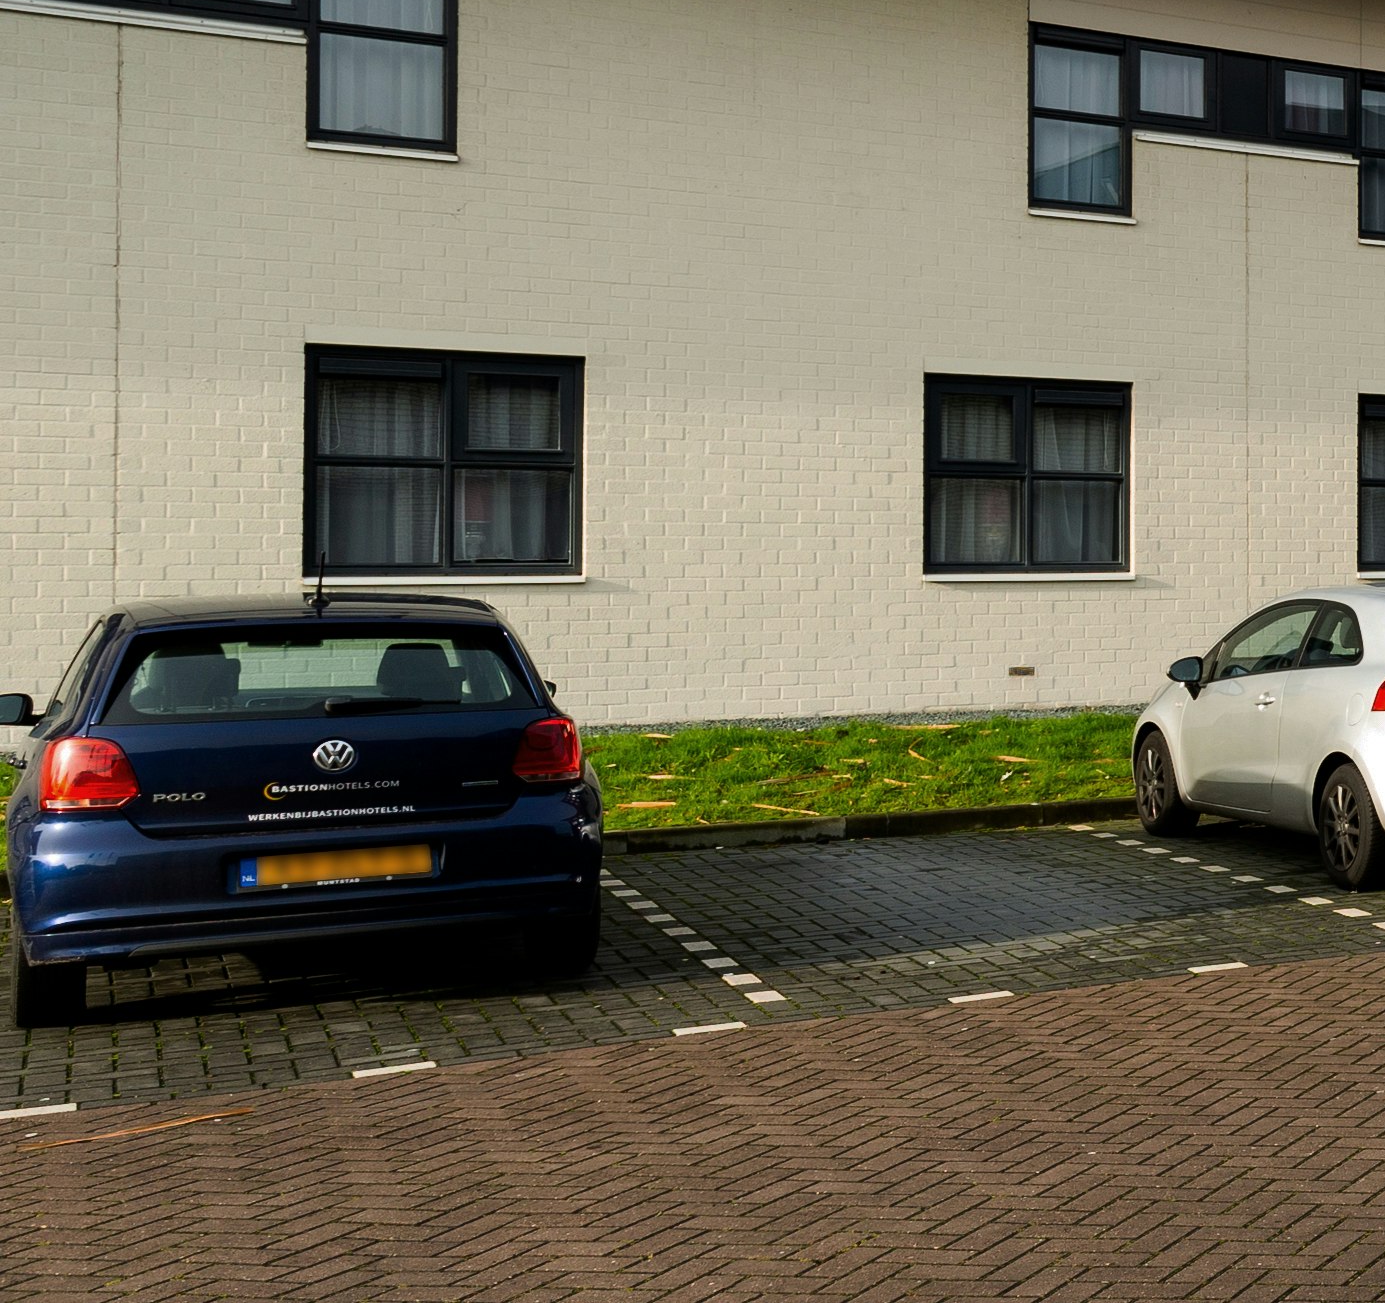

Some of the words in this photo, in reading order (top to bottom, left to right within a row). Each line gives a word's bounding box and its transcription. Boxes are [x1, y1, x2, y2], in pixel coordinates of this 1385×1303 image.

[271, 780, 400, 794] BASTIONHOTELS.COM
[152, 792, 206, 803] POLO
[248, 805, 416, 822] WERKENBIJBASTIONHOTELS.NL
[241, 875, 256, 883] NL
